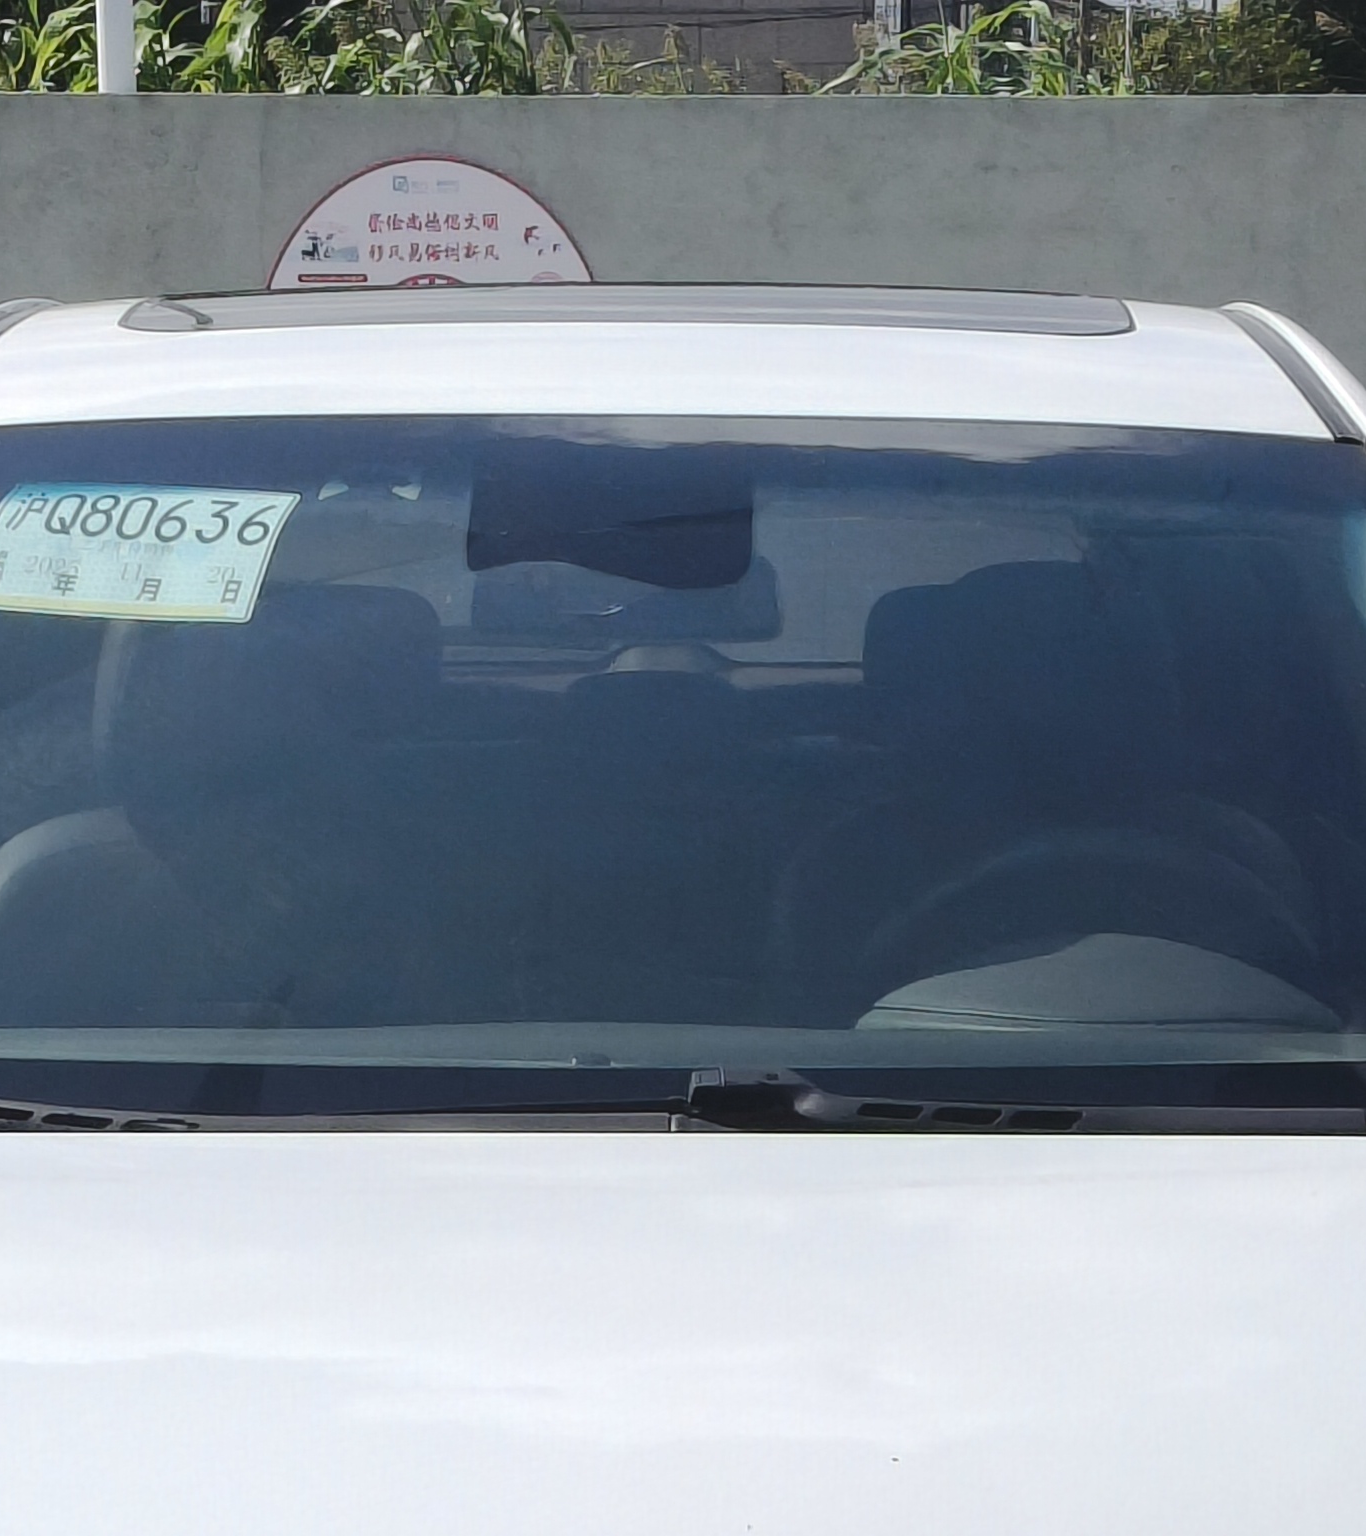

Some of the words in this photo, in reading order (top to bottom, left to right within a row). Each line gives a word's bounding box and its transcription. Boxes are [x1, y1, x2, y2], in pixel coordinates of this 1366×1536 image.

[5, 492, 279, 546] 沪Q80636
[51, 571, 79, 597] 年
[135, 578, 162, 602] 月
[221, 580, 242, 604] 日
